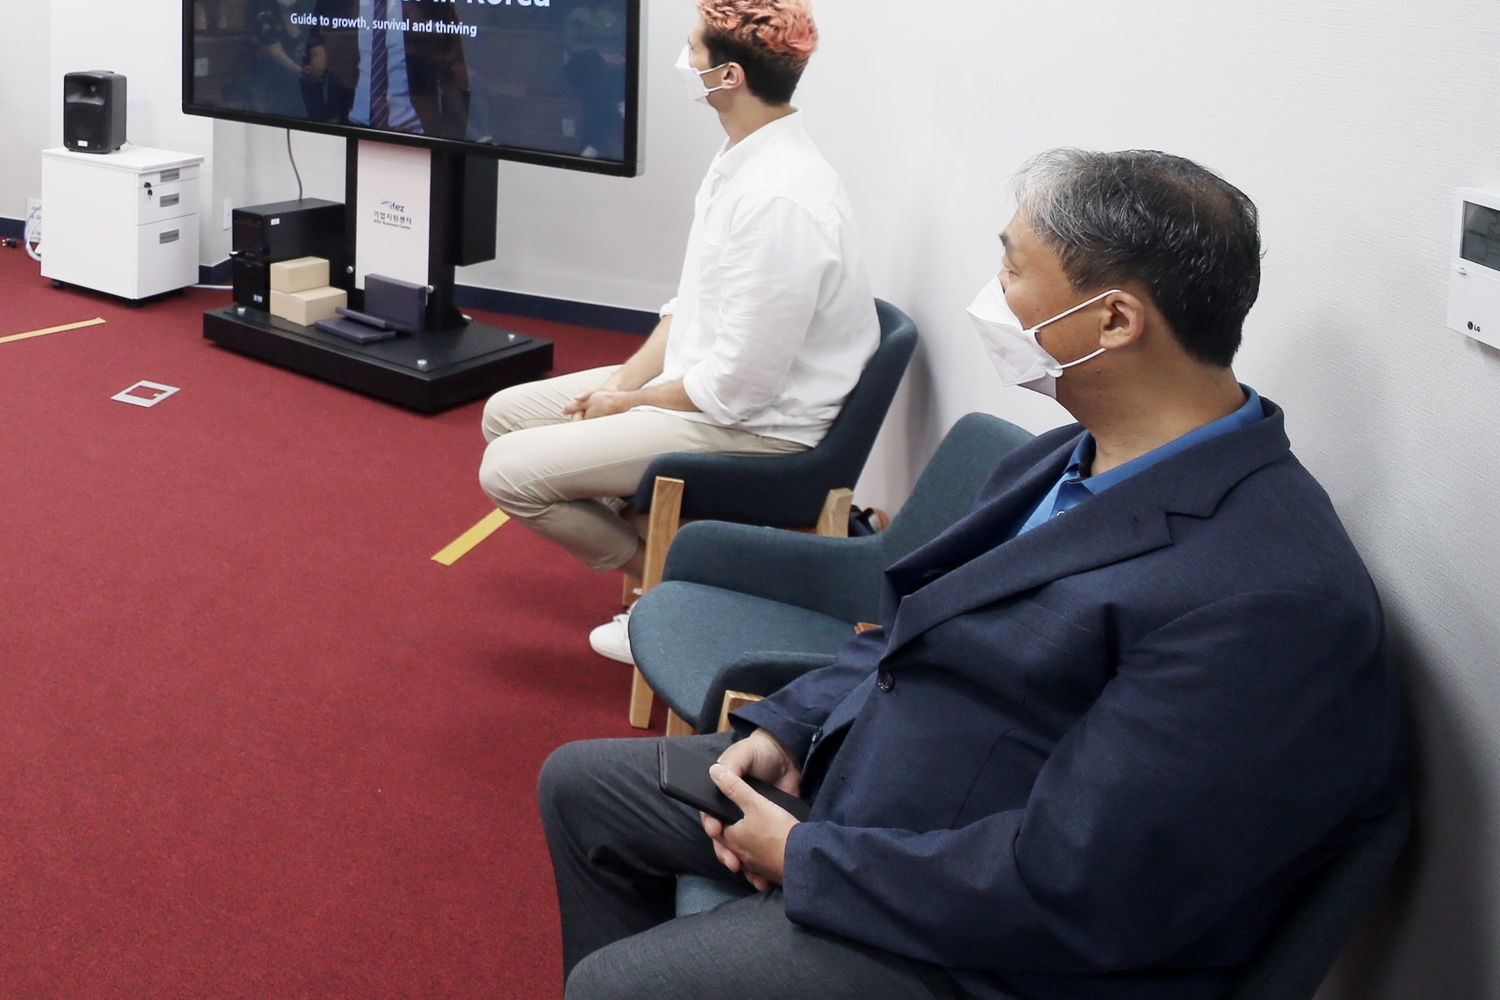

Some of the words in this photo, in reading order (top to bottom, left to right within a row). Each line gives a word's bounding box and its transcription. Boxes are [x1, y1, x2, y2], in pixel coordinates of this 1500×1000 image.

[290, 13, 318, 26] Guide
[320, 15, 331, 27] to
[332, 16, 370, 32] growth,
[372, 19, 410, 32] survival
[412, 21, 433, 34] and
[435, 22, 478, 38] thriving
